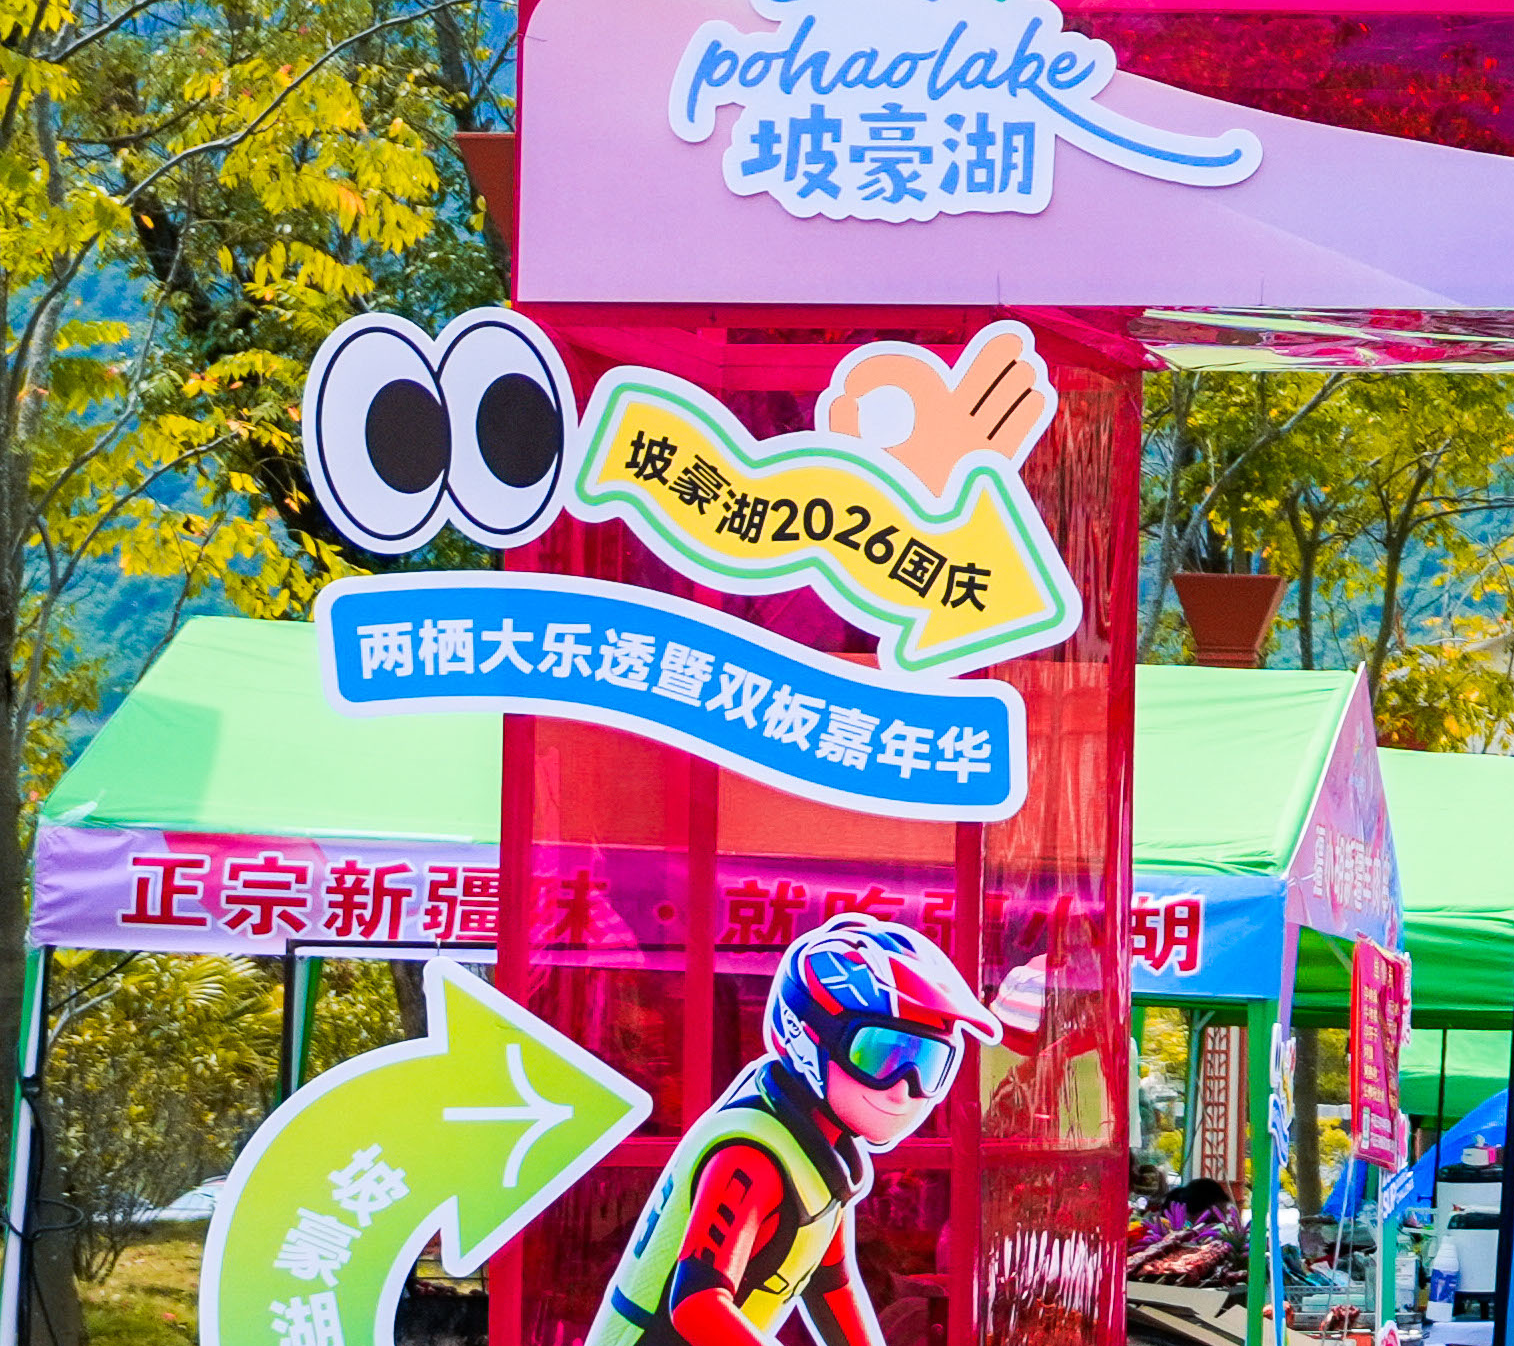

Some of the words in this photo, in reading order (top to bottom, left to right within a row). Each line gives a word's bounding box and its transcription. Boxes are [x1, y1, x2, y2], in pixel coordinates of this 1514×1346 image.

[740, 105, 1035, 203] 坡豪湖
[624, 429, 992, 612] 坡豪湖2026国庆
[357, 617, 992, 786] 两栖大乐透暨双板嘉年华
